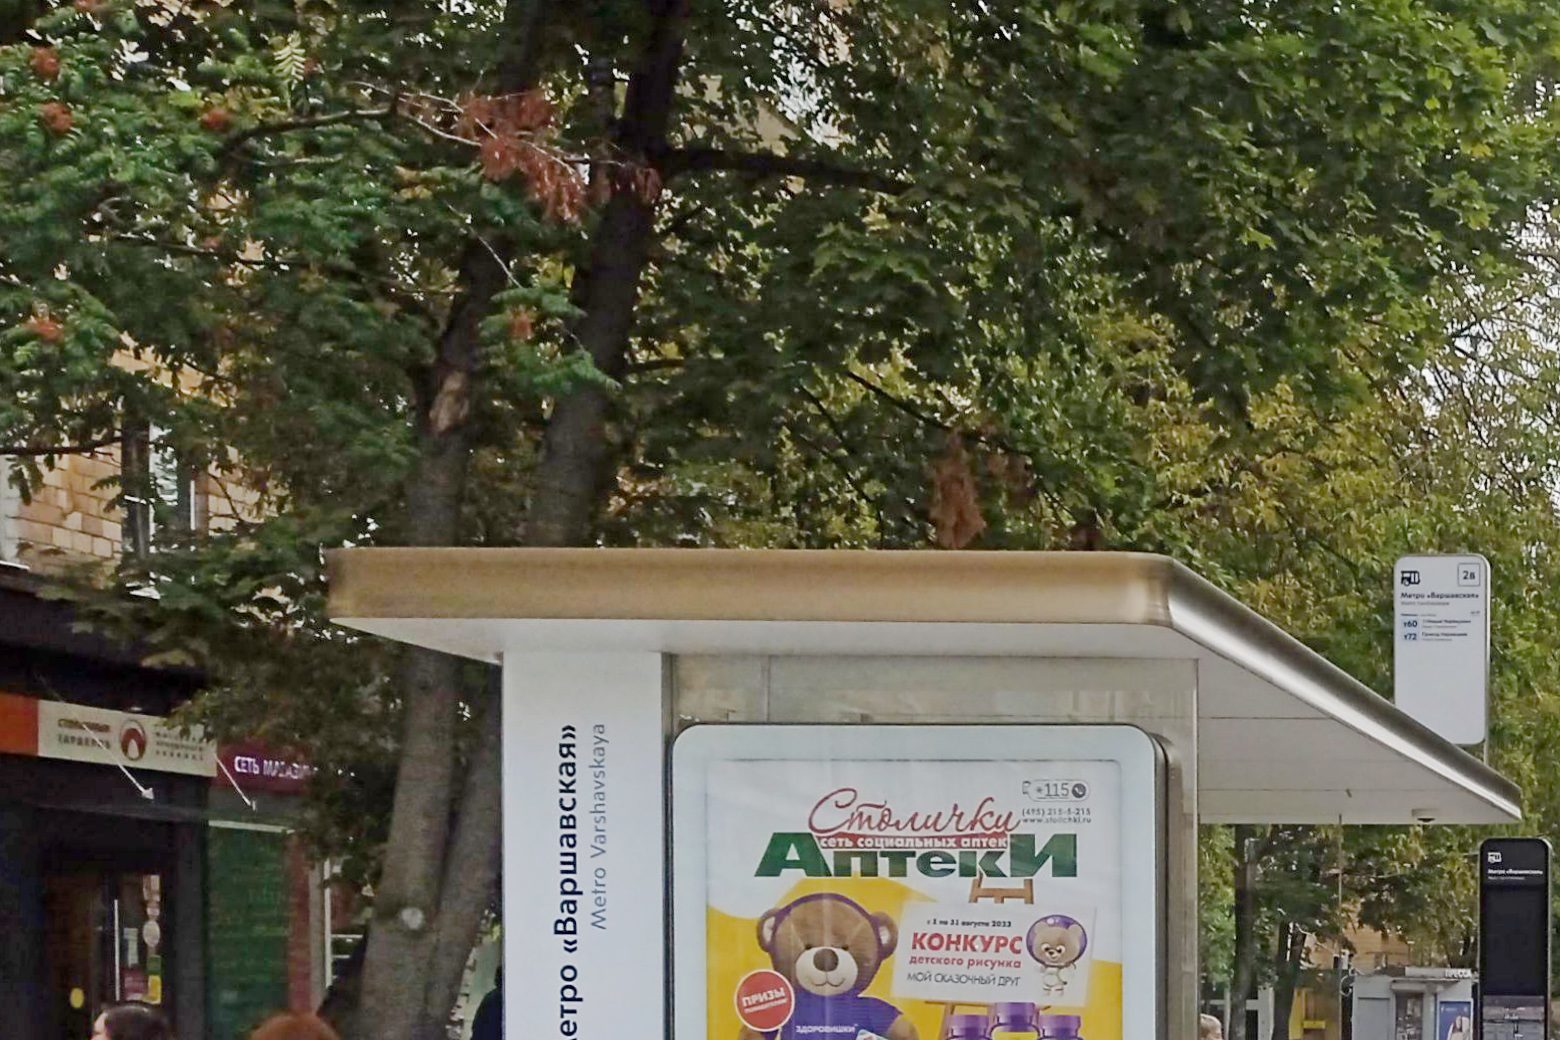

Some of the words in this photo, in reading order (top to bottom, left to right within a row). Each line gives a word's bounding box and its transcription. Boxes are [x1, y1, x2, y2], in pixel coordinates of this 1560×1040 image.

[234, 756, 260, 775] СЕТЬ
[589, 724, 609, 858] Varshavskaya
[808, 787, 1021, 833] Столички
[554, 724, 583, 954] «Варшавская»
[820, 838, 854, 849] сеть
[857, 837, 956, 850] социальных
[961, 838, 1007, 849] аптек
[590, 867, 607, 930] Metro
[911, 931, 1023, 955] КОНКУРС
[908, 955, 964, 965] детского
[967, 957, 1021, 970] рисунка
[907, 971, 932, 982] МОЙ
[934, 972, 996, 985] СКАЗОЧНЫЙ
[997, 976, 1021, 987] ДРУГ
[742, 987, 786, 1007] ПРИЗЫ
